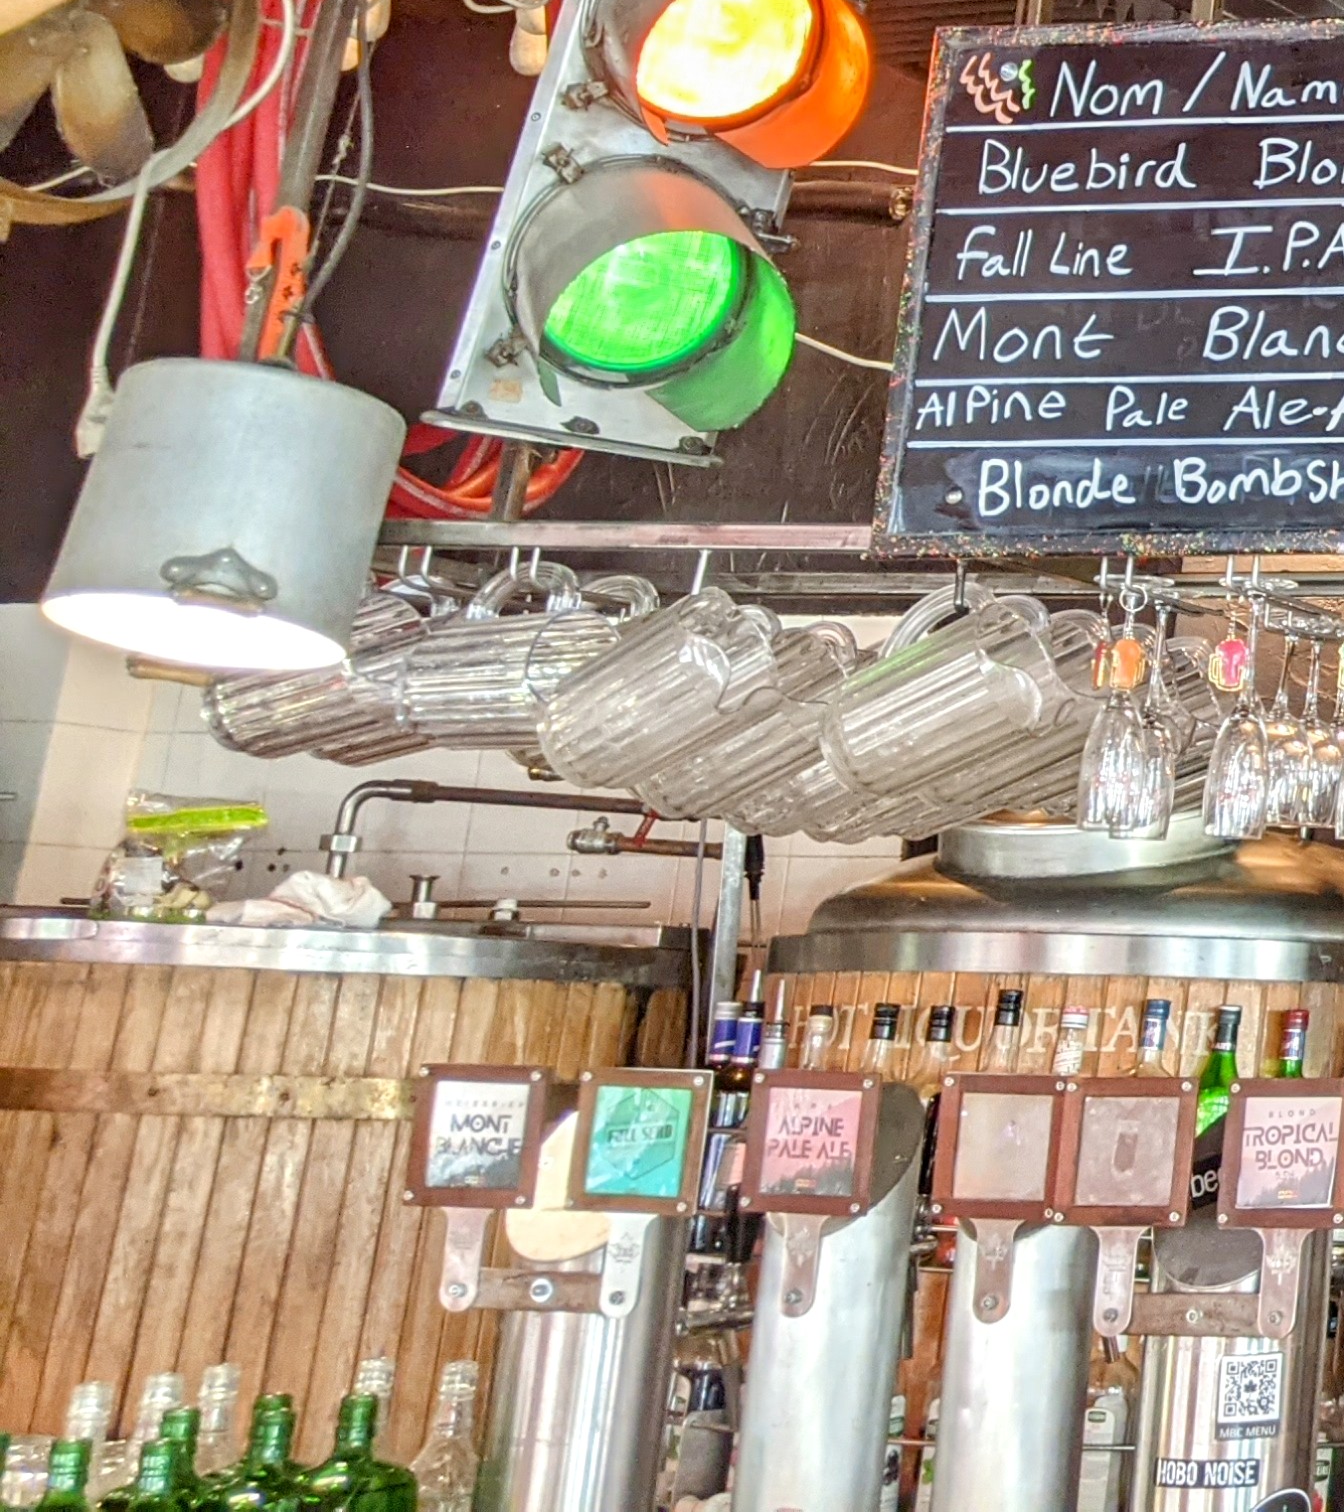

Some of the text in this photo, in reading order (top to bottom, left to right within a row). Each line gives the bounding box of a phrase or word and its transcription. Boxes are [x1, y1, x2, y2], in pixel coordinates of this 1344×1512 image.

[1050, 68, 1163, 118] Nom
[978, 139, 1197, 195] Bluebird
[1048, 230, 1134, 278] Line
[932, 307, 1115, 362] Mont
[1105, 388, 1189, 427] Pale
[978, 459, 1136, 517] Blonde
[450, 1113, 512, 1133] MONT
[1268, 1108, 1317, 1119] BLOND
[778, 1116, 844, 1138] ALPINE
[1243, 1121, 1339, 1147] TROPICAL
[436, 1137, 522, 1160] BLANCHE
[768, 1139, 851, 1160] PALE ALE
[1254, 1147, 1324, 1170] BLOND
[1245, 1424, 1277, 1437] MENU
[1156, 1458, 1199, 1487] HOBO
